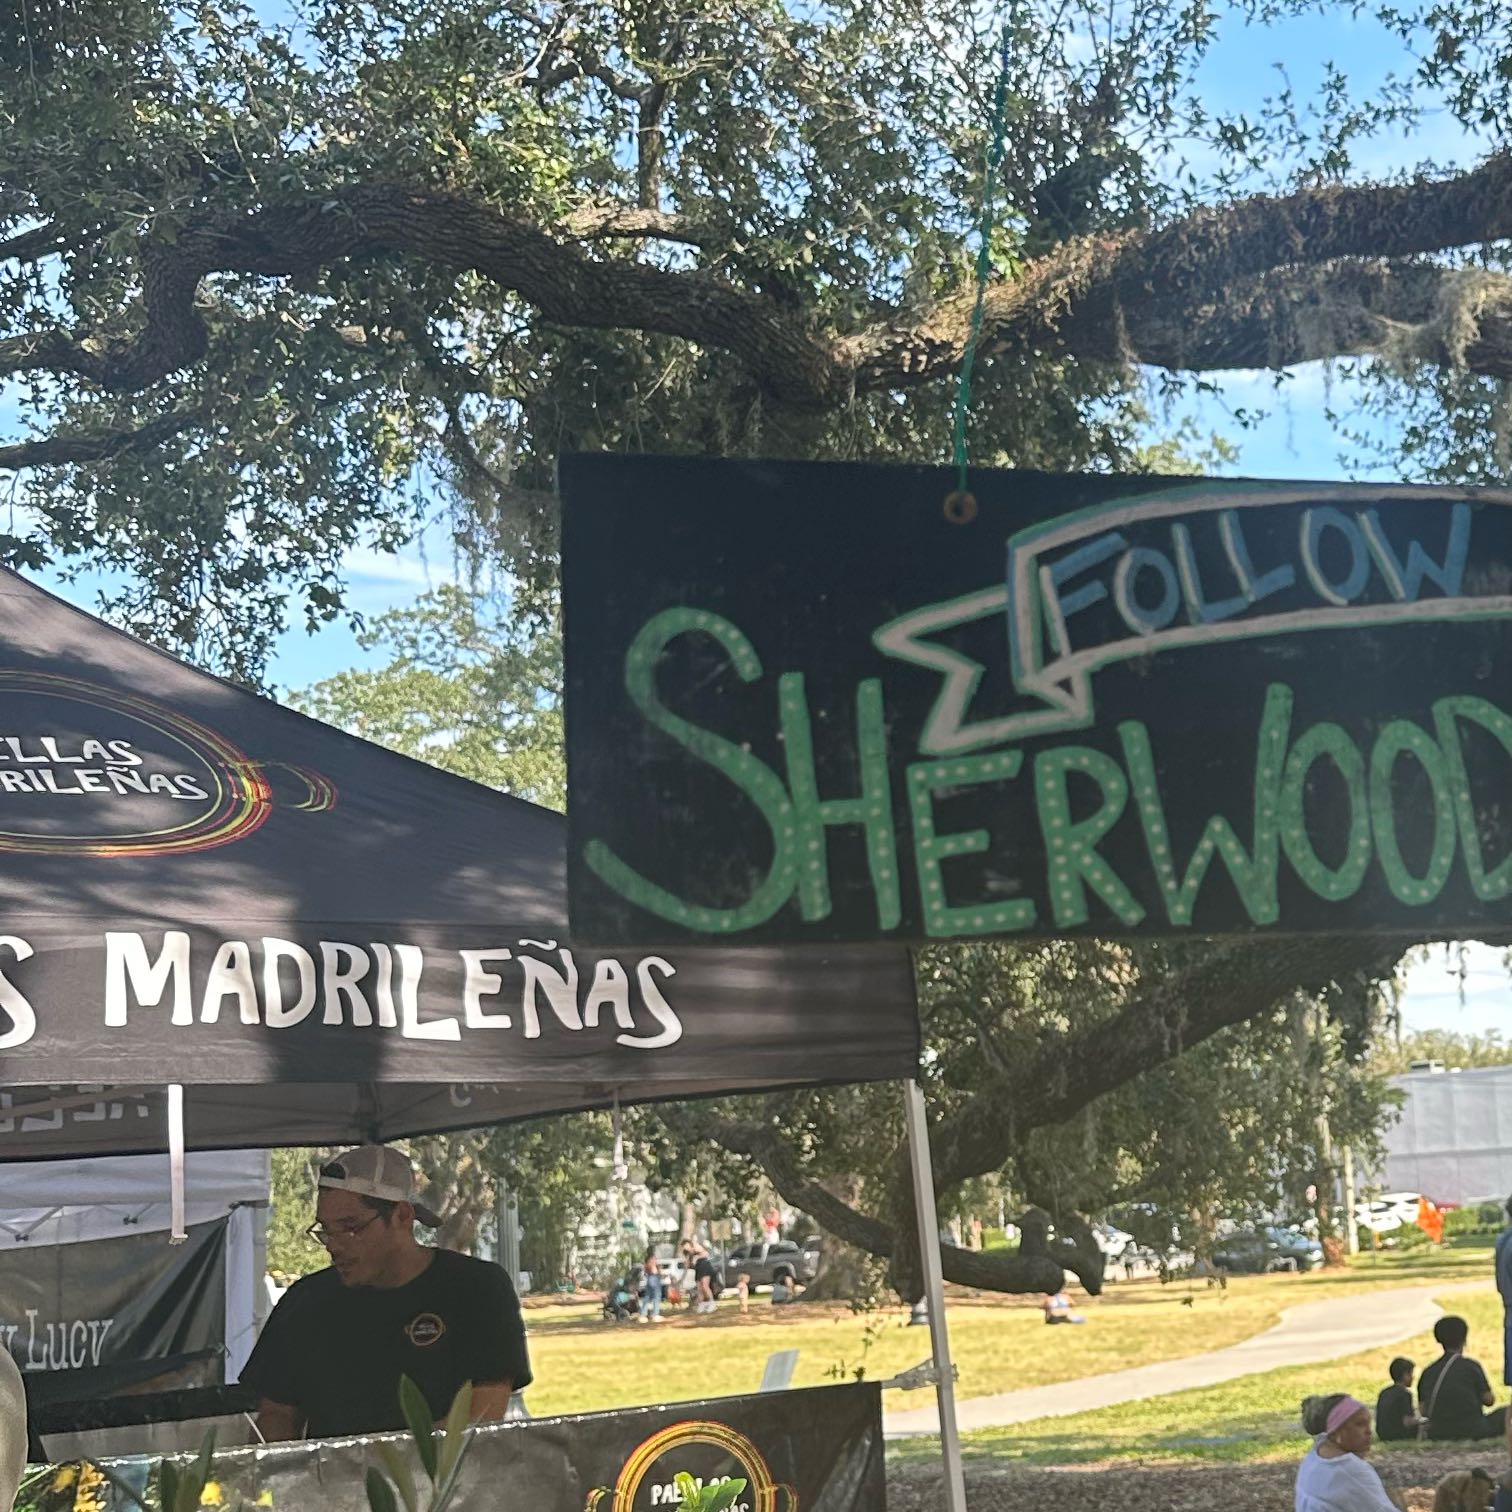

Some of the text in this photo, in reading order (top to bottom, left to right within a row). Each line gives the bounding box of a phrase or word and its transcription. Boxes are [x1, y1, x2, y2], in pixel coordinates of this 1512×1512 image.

[1040, 503, 1471, 656] FOLLOW
[0, 766, 209, 800] RILEÑAS
[104, 931, 683, 1049] MADRILEÑAS
